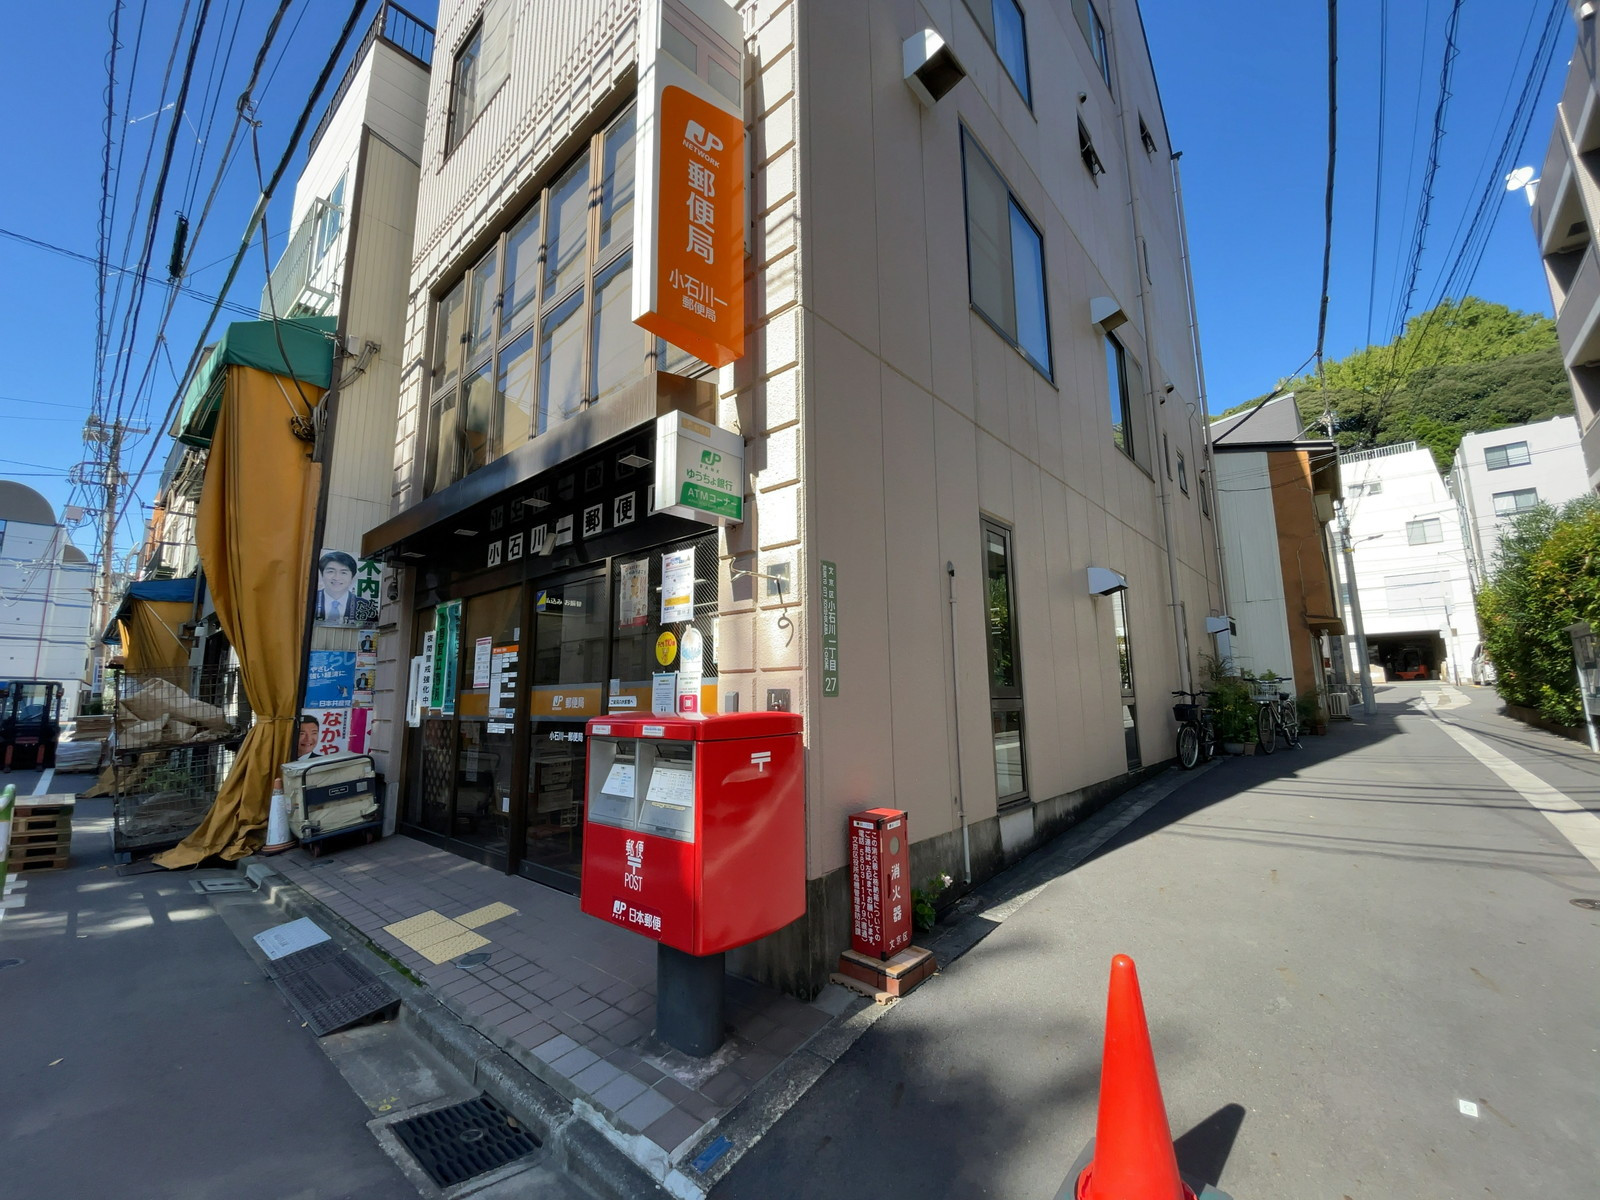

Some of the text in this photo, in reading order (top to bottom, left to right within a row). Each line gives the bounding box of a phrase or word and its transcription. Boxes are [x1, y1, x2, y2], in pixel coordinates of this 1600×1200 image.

[682, 139, 720, 168] NETWORK
[686, 159, 715, 265] 郵便局
[669, 268, 728, 307] 小石川一
[682, 295, 717, 323] 郵便局
[686, 468, 734, 492] ゆうちょ銀行
[687, 487, 738, 507] ATMコーナー
[488, 486, 656, 565] 小石川一郵便
[310, 652, 355, 666] 暮らし
[825, 677, 837, 692] 27
[565, 696, 585, 708] 郵便局
[549, 731, 584, 742] 小石川一郵便局
[858, 829, 865, 845] 電話
[625, 839, 645, 859] 郵便
[624, 872, 643, 892] POST
[891, 863, 902, 923] 消火器
[612, 912, 626, 921] POST
[628, 908, 662, 932] 日本郵便
[889, 931, 908, 950] 文京区
